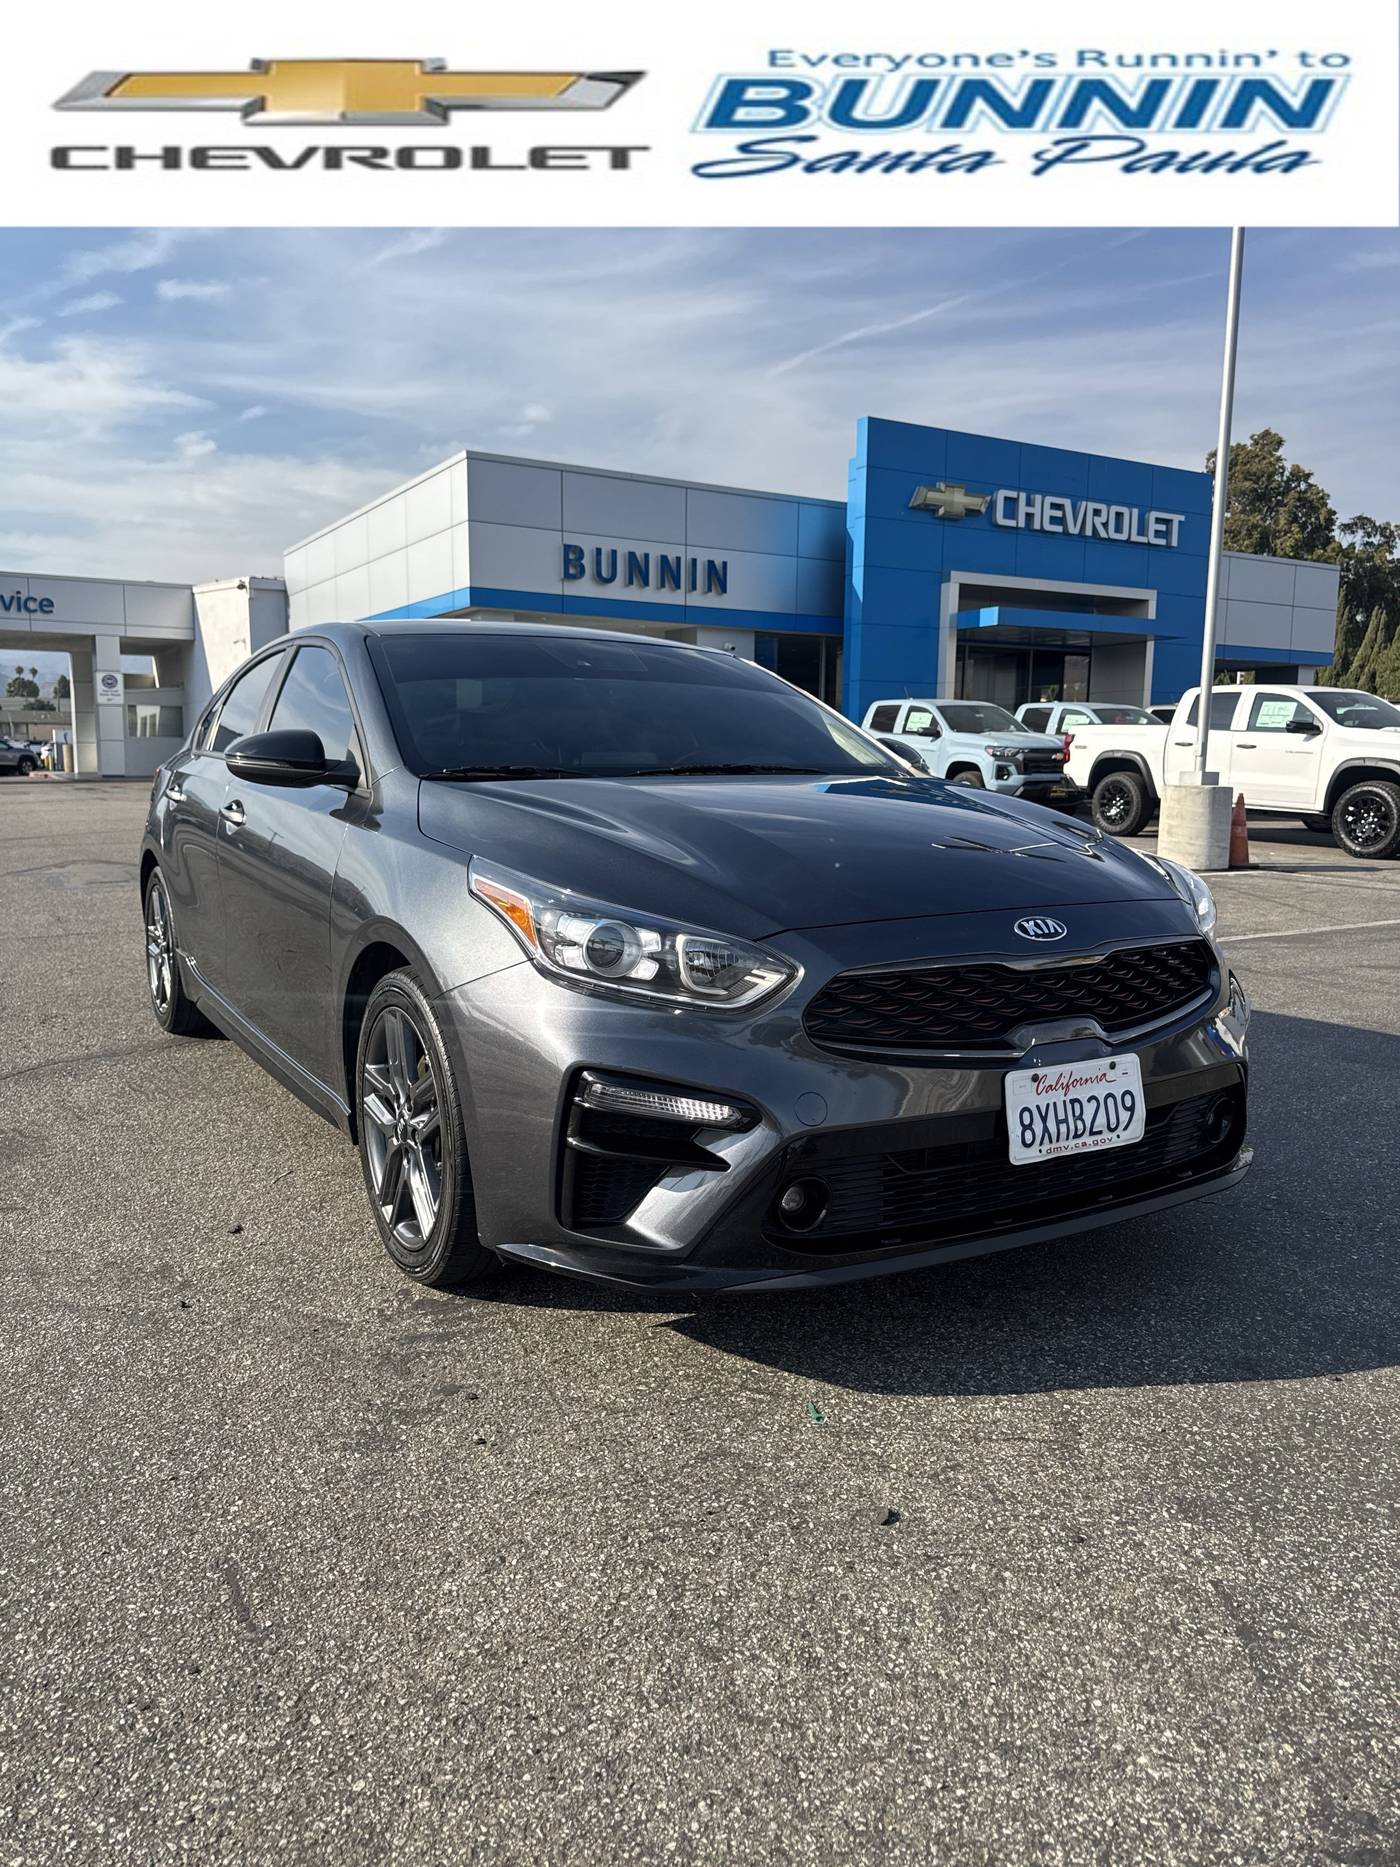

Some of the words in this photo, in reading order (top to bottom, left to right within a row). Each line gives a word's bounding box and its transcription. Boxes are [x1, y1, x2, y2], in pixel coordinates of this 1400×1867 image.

[994, 488, 1185, 548] CHEVROLET
[561, 542, 729, 595] BUNNIN
[1020, 919, 1063, 936] KIA
[1035, 1070, 1118, 1098] California
[1018, 1089, 1136, 1149] 8XHB209
[1045, 1135, 1114, 1155] dmv.ca.gov
